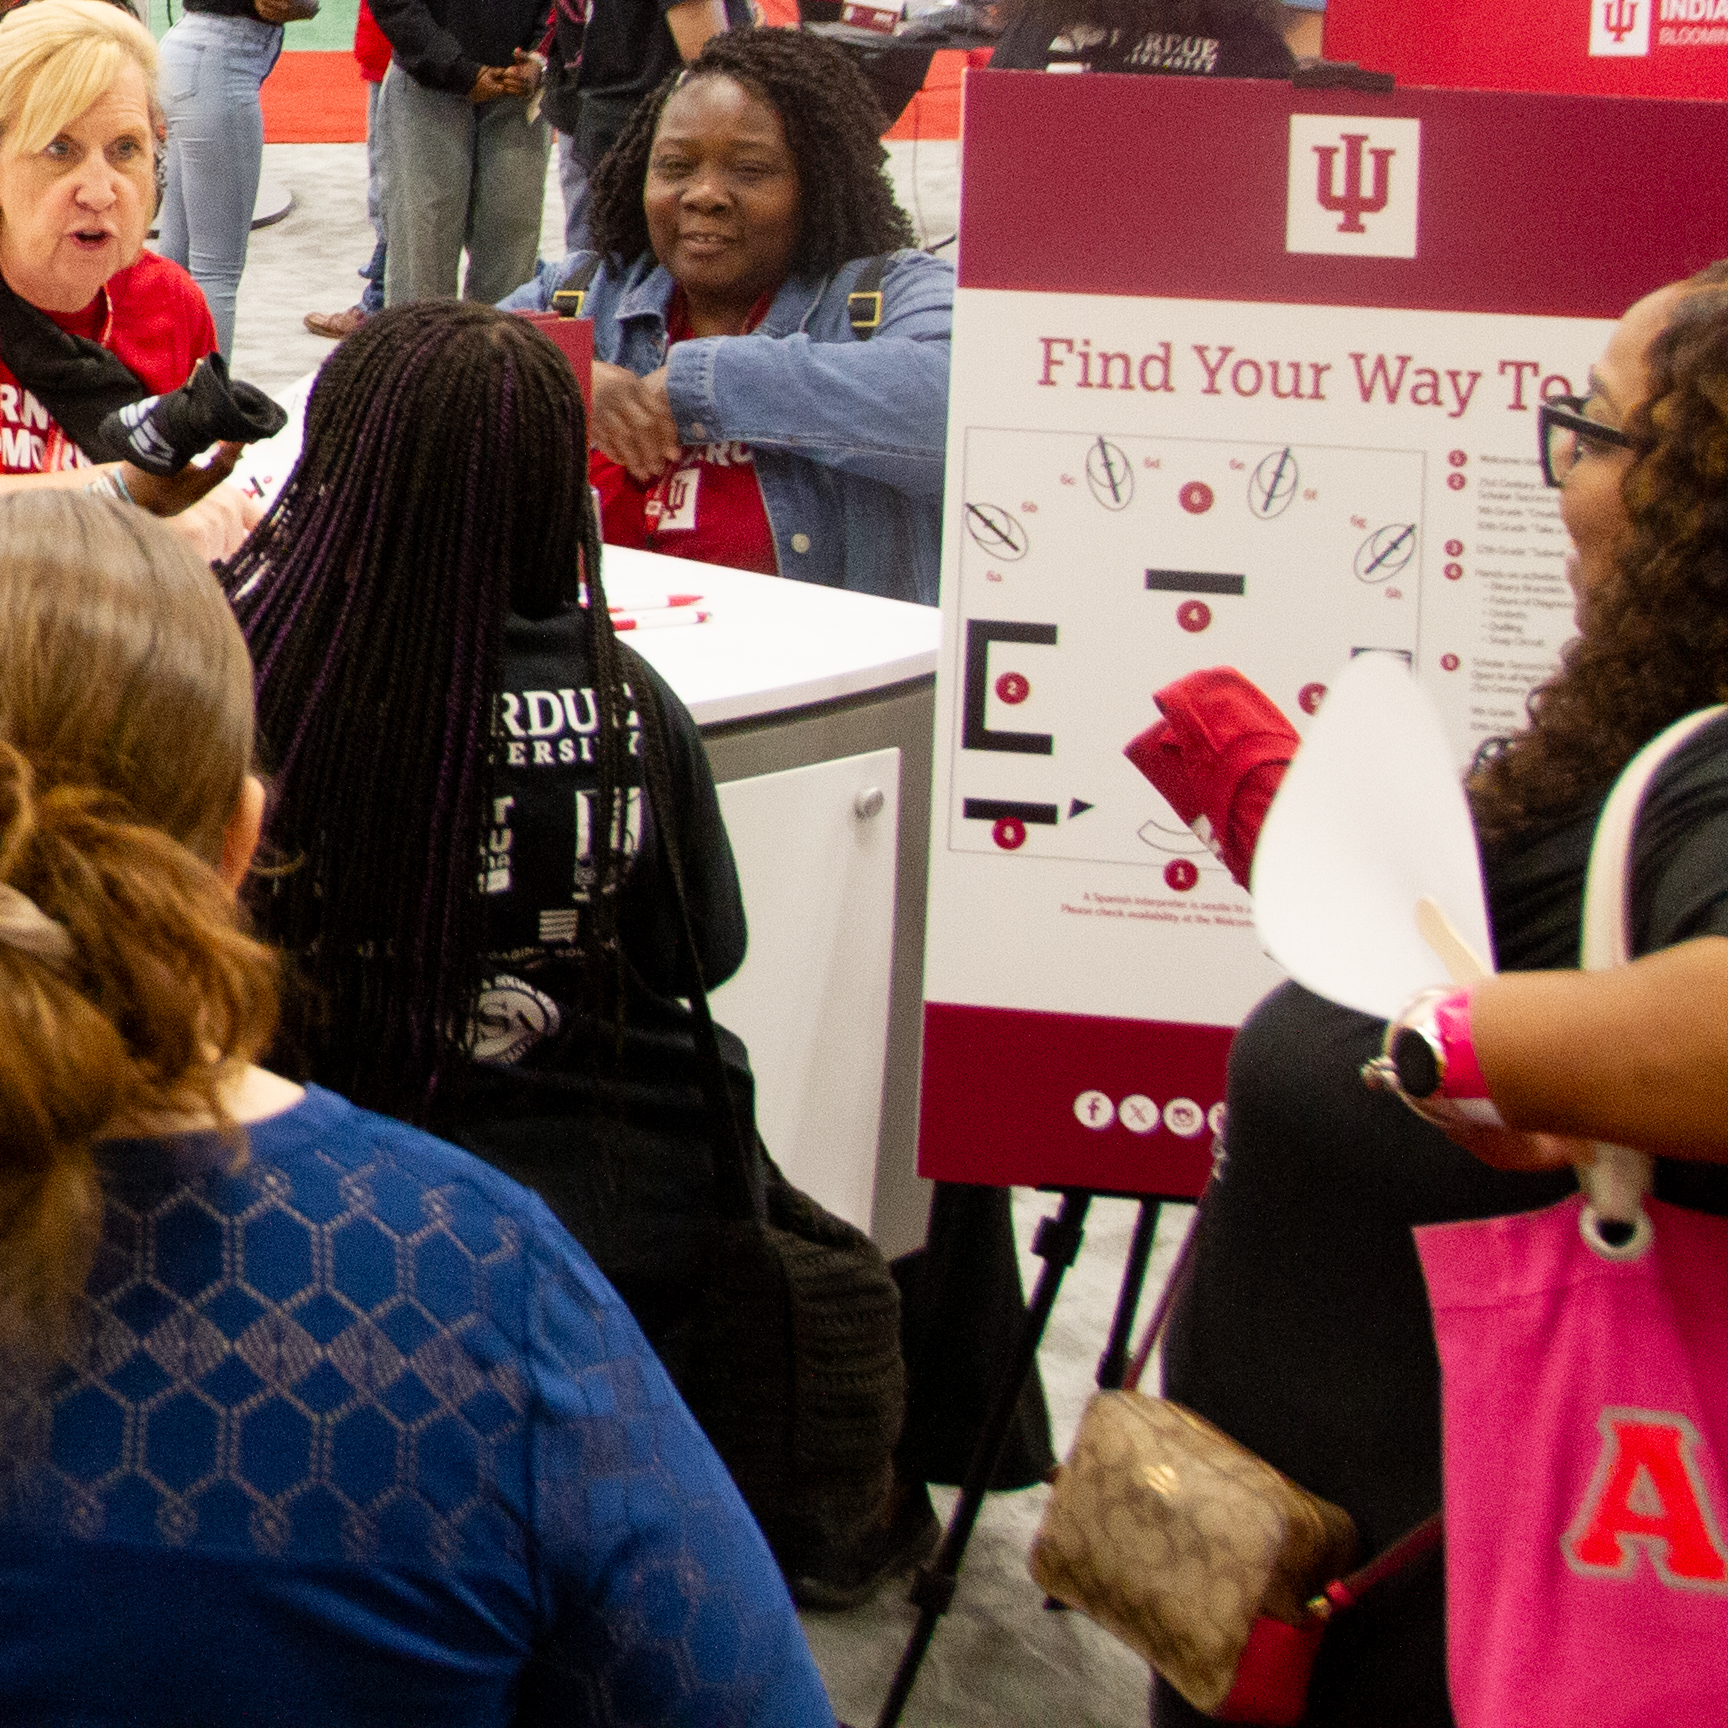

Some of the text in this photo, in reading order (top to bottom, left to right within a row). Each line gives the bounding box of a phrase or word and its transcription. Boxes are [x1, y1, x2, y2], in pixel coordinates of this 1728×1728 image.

[1037, 335, 1176, 396] Find
[1192, 344, 1332, 403] Your
[1349, 352, 1484, 418] Way
[491, 685, 601, 739] RDU
[505, 735, 597, 766] ERSI
[1214, 916, 1255, 929] Welcom
[1561, 1406, 1728, 1594] A
